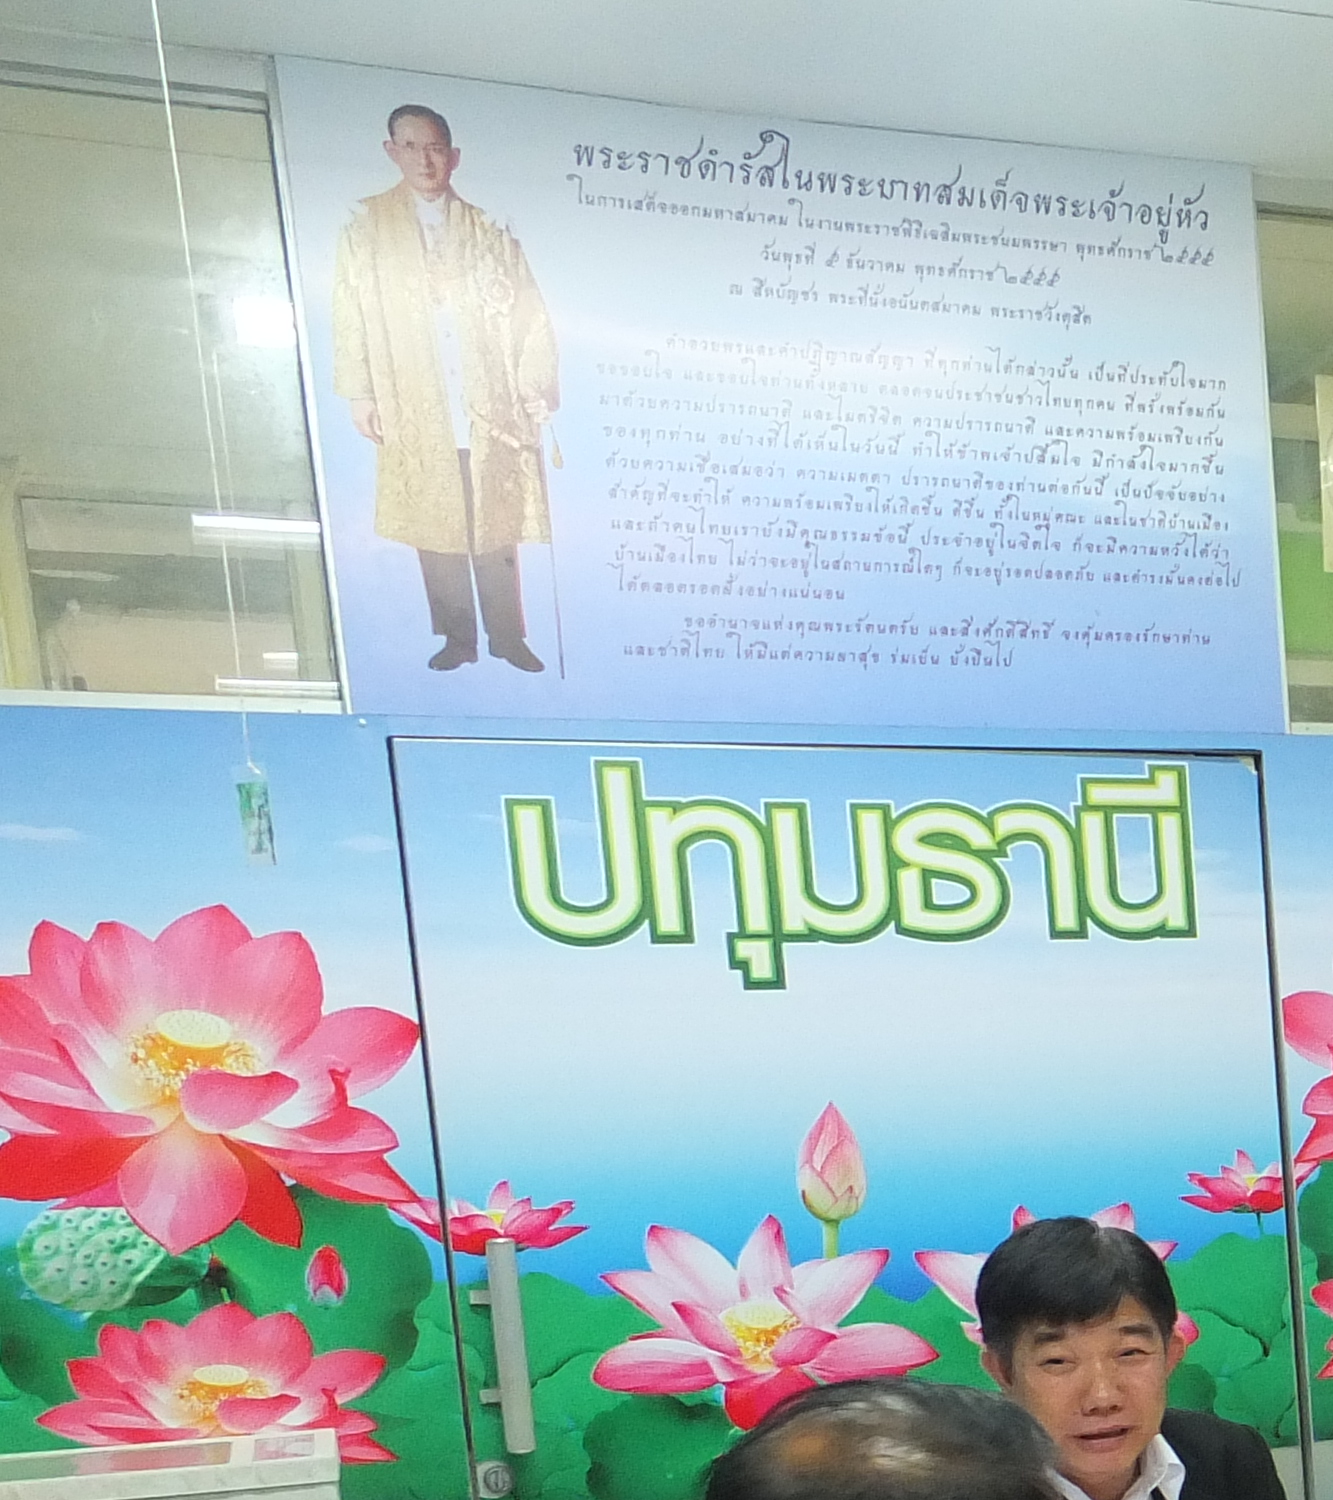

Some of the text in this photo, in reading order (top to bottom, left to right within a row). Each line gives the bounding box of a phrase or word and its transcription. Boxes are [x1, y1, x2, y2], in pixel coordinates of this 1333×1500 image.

[573, 130, 1209, 243] พระราชดำรัสในพระบาทสมเด็จพระเจ้าอยู่หัว
[504, 758, 1199, 990] ปทุมธานี
